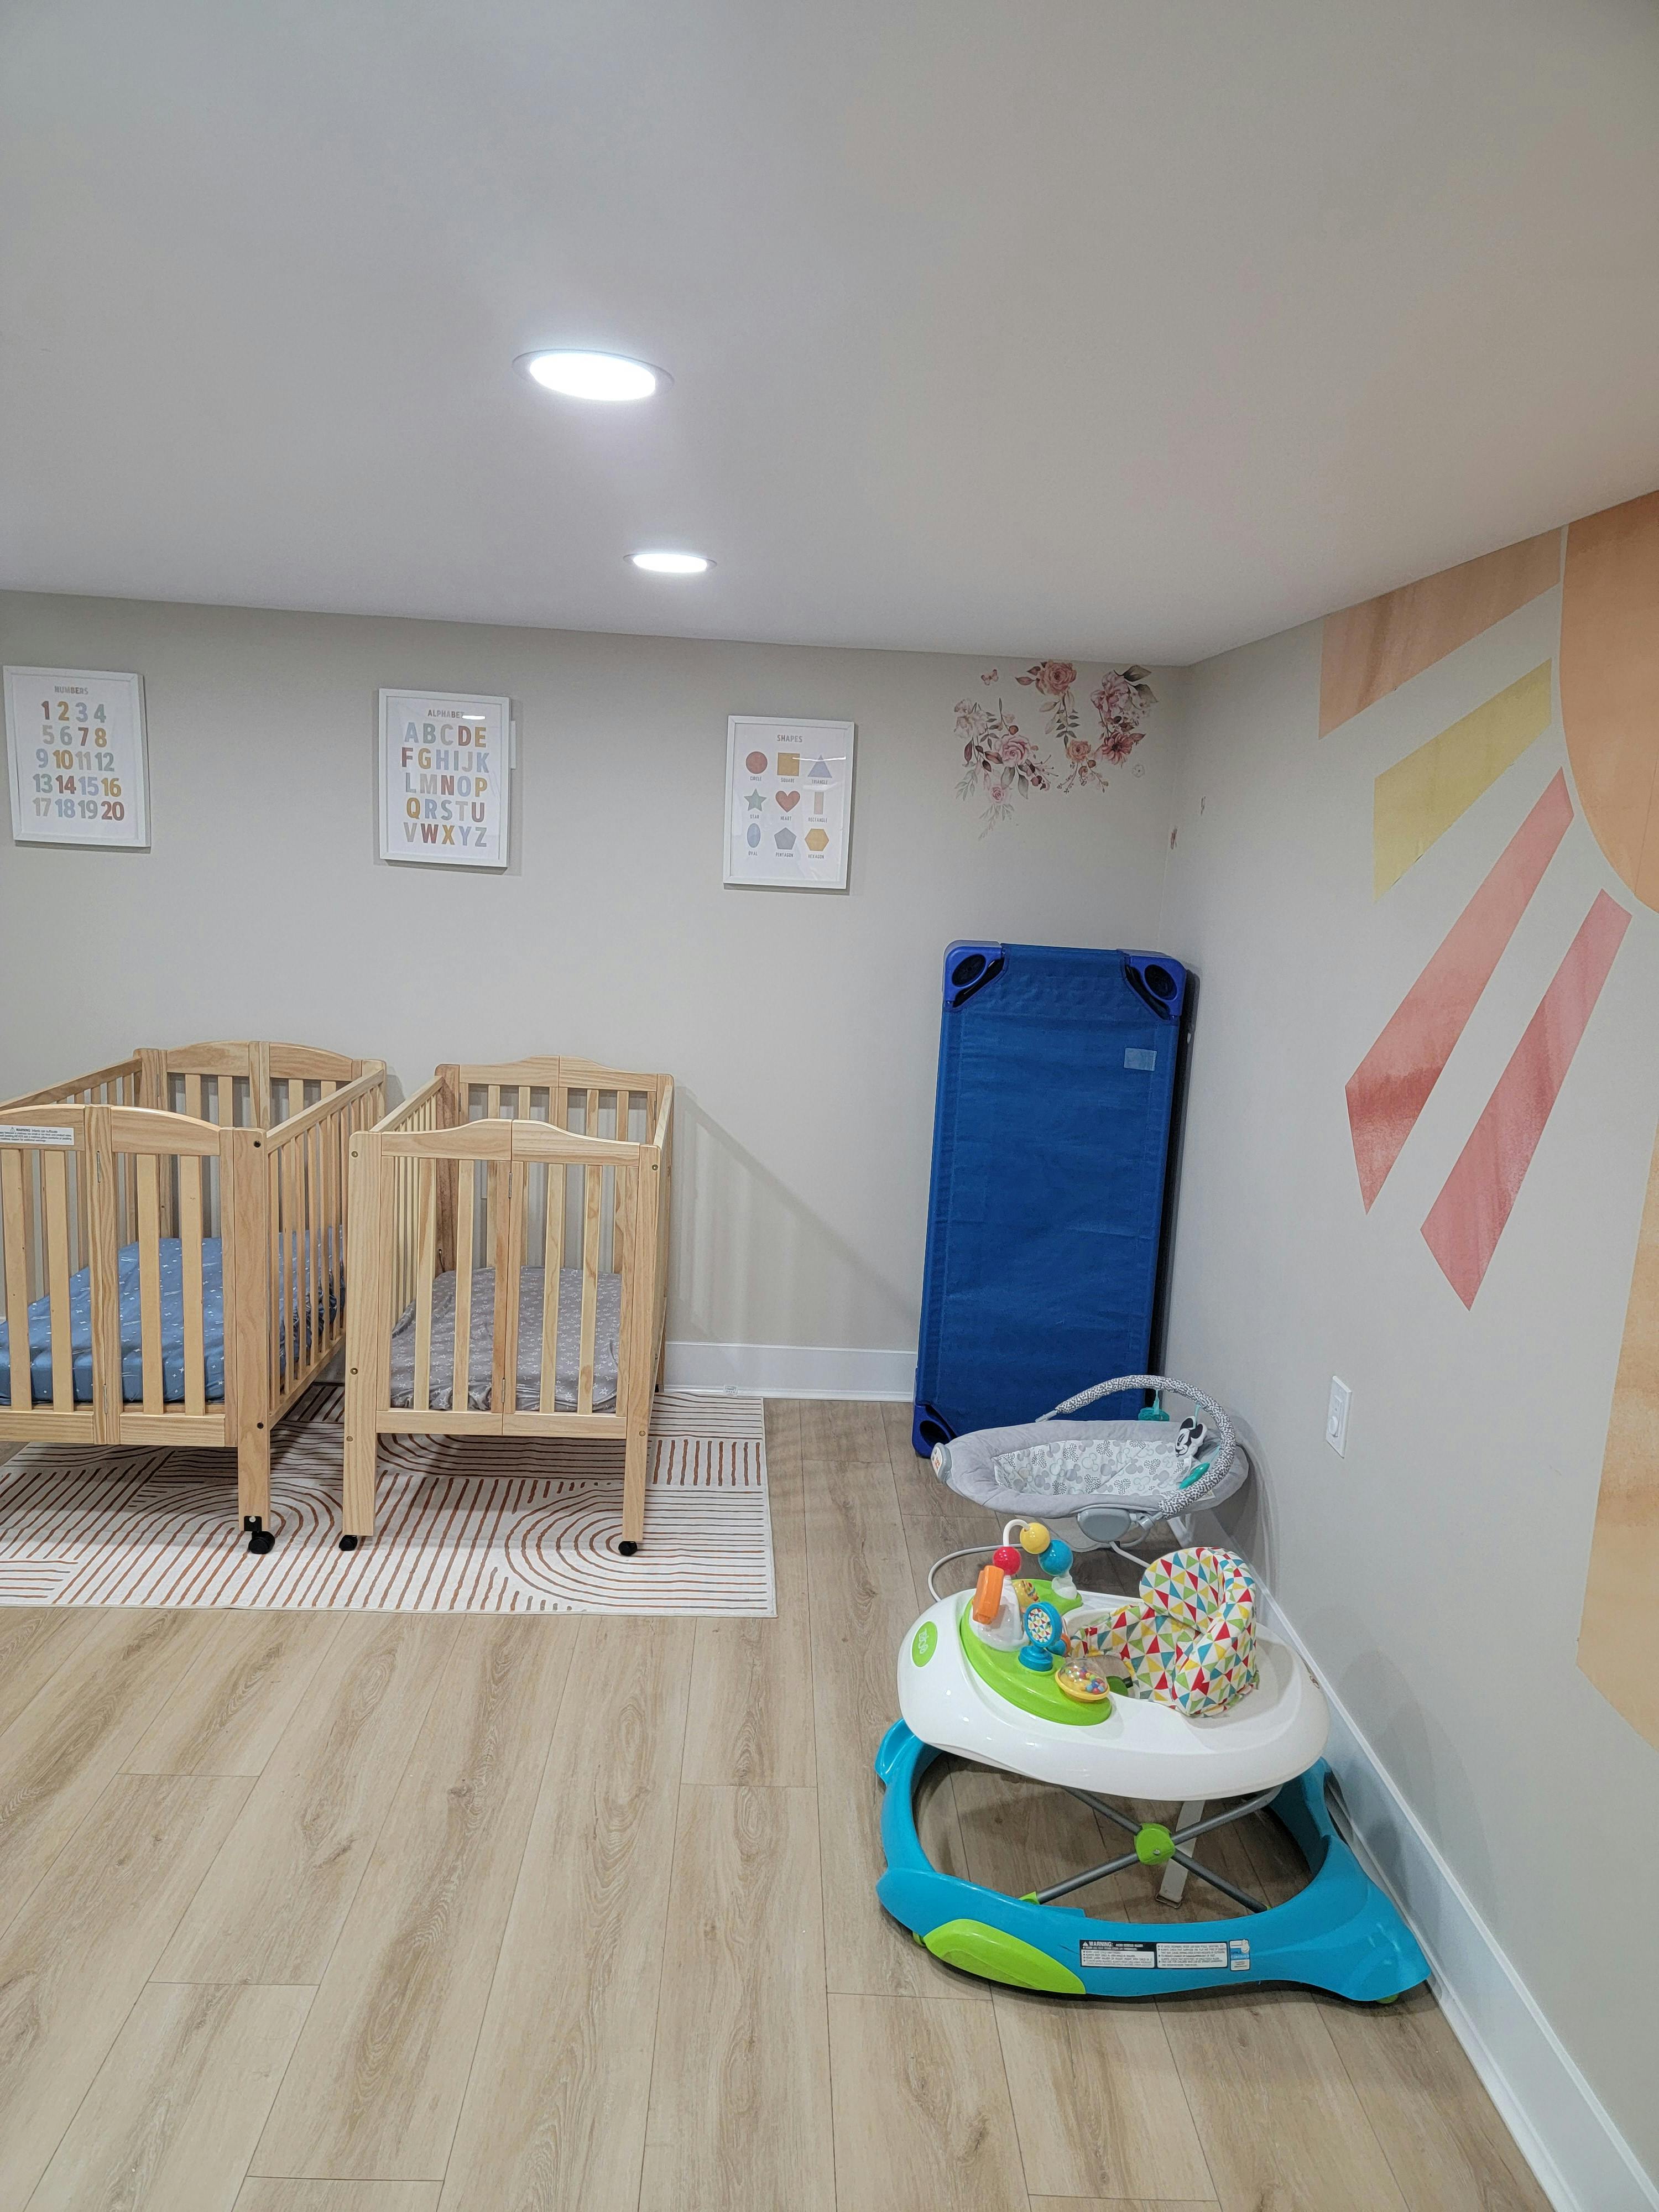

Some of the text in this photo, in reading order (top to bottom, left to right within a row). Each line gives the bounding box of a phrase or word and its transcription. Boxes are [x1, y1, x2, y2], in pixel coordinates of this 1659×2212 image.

[55, 686, 88, 695] NUMBERS
[41, 701, 106, 723] 1 2 3 4
[42, 725, 107, 747] 5 6 7 8
[777, 734, 802, 743] SHAPES
[36, 748, 114, 772] 9 10 11 12
[33, 774, 122, 797] 13 14 15 16
[32, 797, 125, 821] 17 18 19 20
